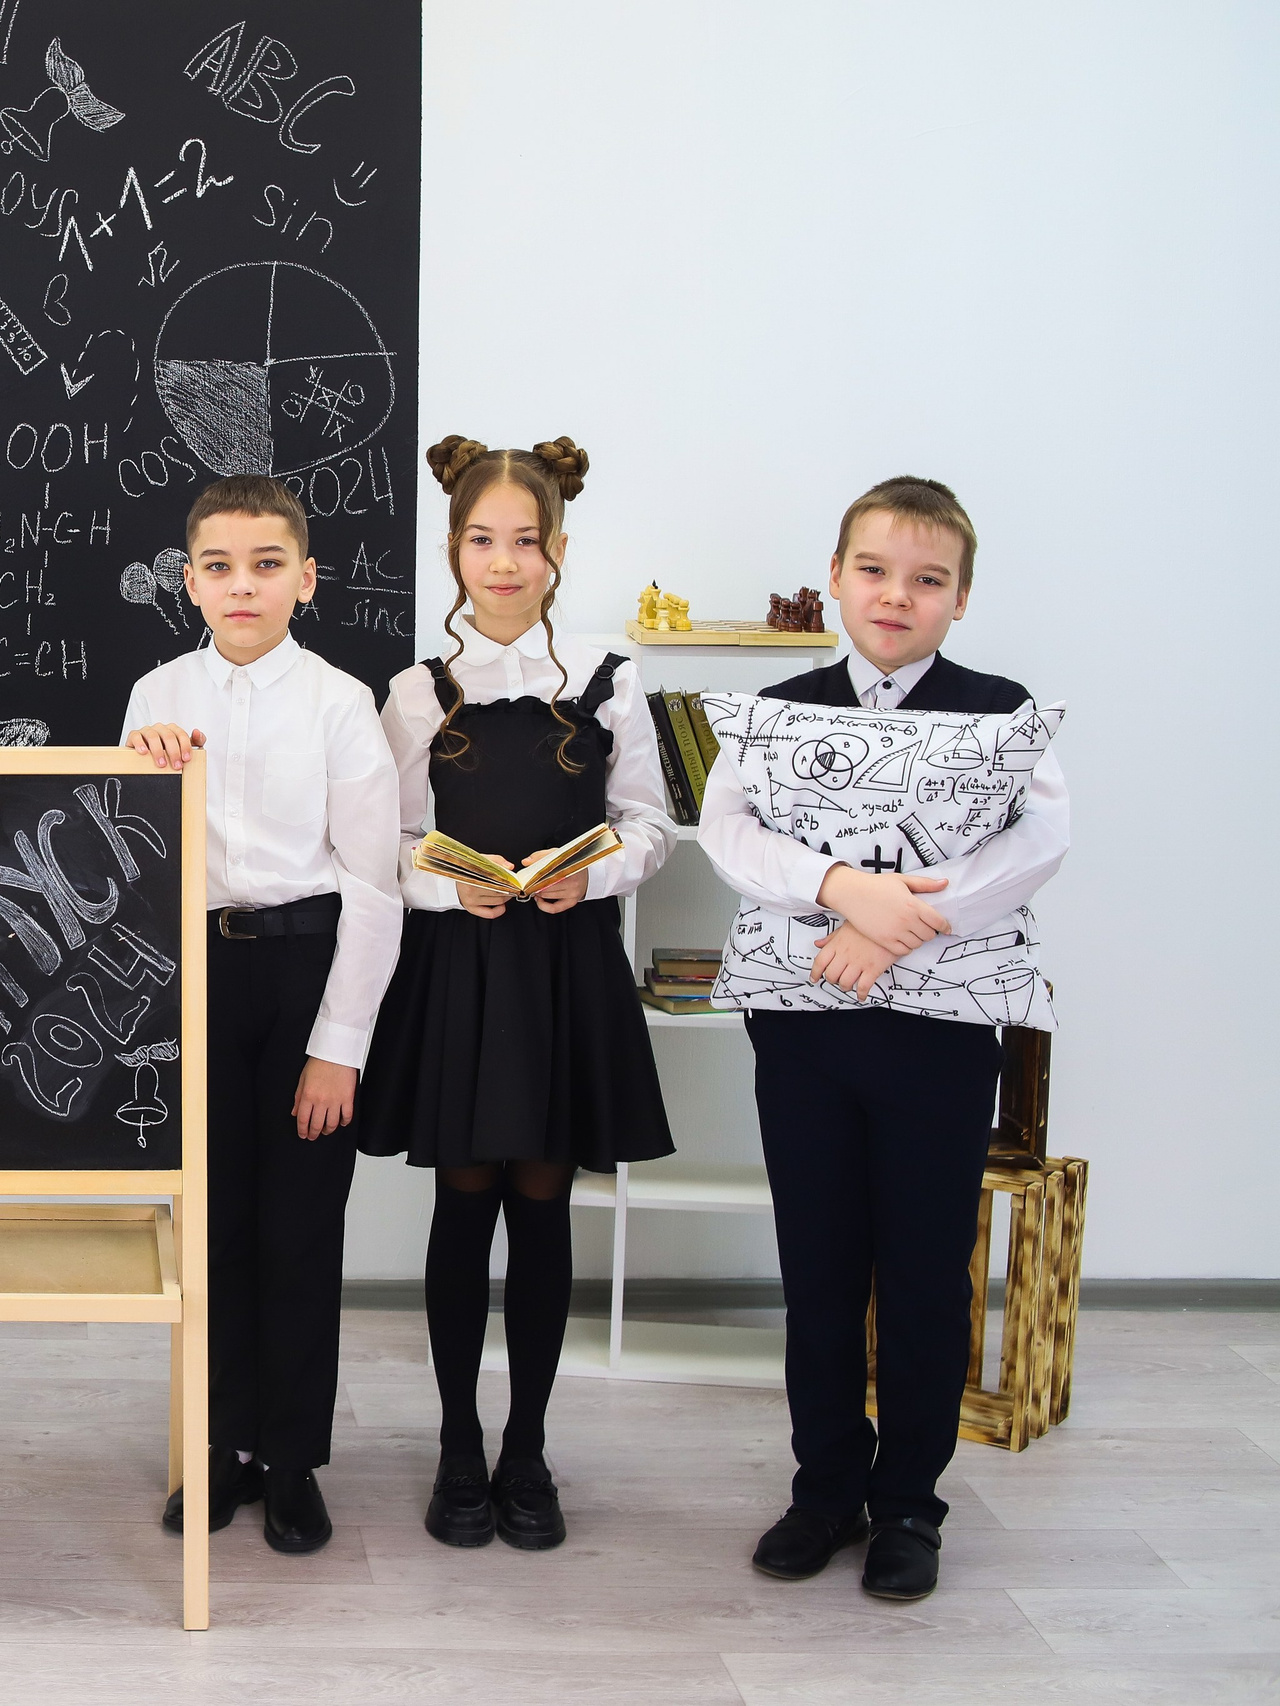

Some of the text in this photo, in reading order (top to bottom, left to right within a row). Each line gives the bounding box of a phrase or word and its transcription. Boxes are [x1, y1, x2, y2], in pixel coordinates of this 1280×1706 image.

[183, 21, 356, 154] ABC
[684, 749, 704, 796] МЕННЫЙ
[1, 921, 177, 1117] 2024
